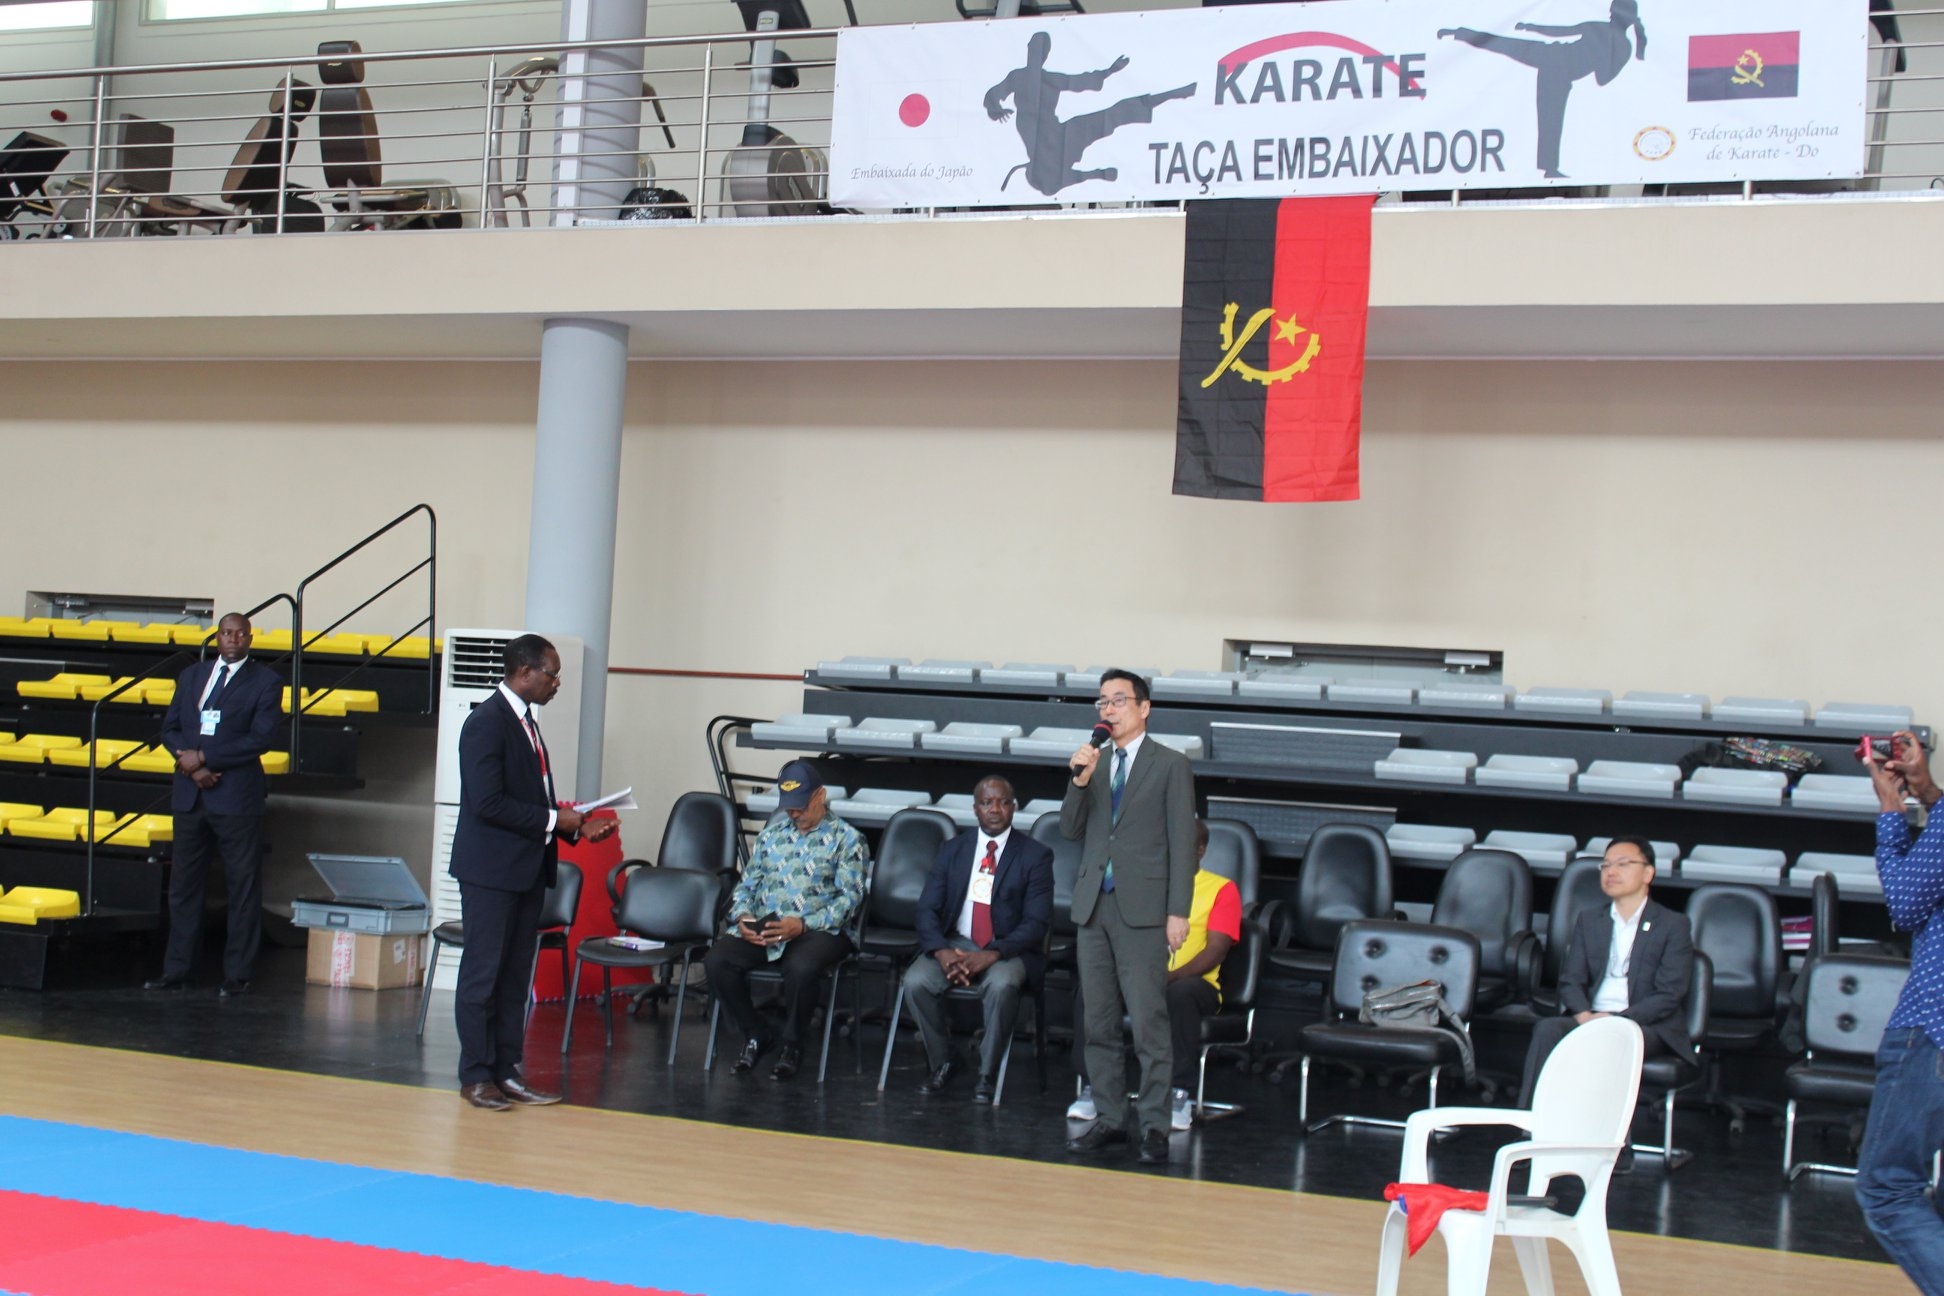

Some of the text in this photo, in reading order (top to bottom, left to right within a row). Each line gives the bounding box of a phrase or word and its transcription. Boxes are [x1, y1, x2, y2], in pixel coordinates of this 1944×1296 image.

[1214, 53, 1427, 105] KARATE
[1688, 120, 1839, 143] Federação Angolana
[1148, 128, 1506, 195] TAÇA EMBAIXADOR
[1706, 146, 1723, 160] de
[1796, 144, 1820, 158] Do
[851, 161, 974, 183] Embaixada do Japão
